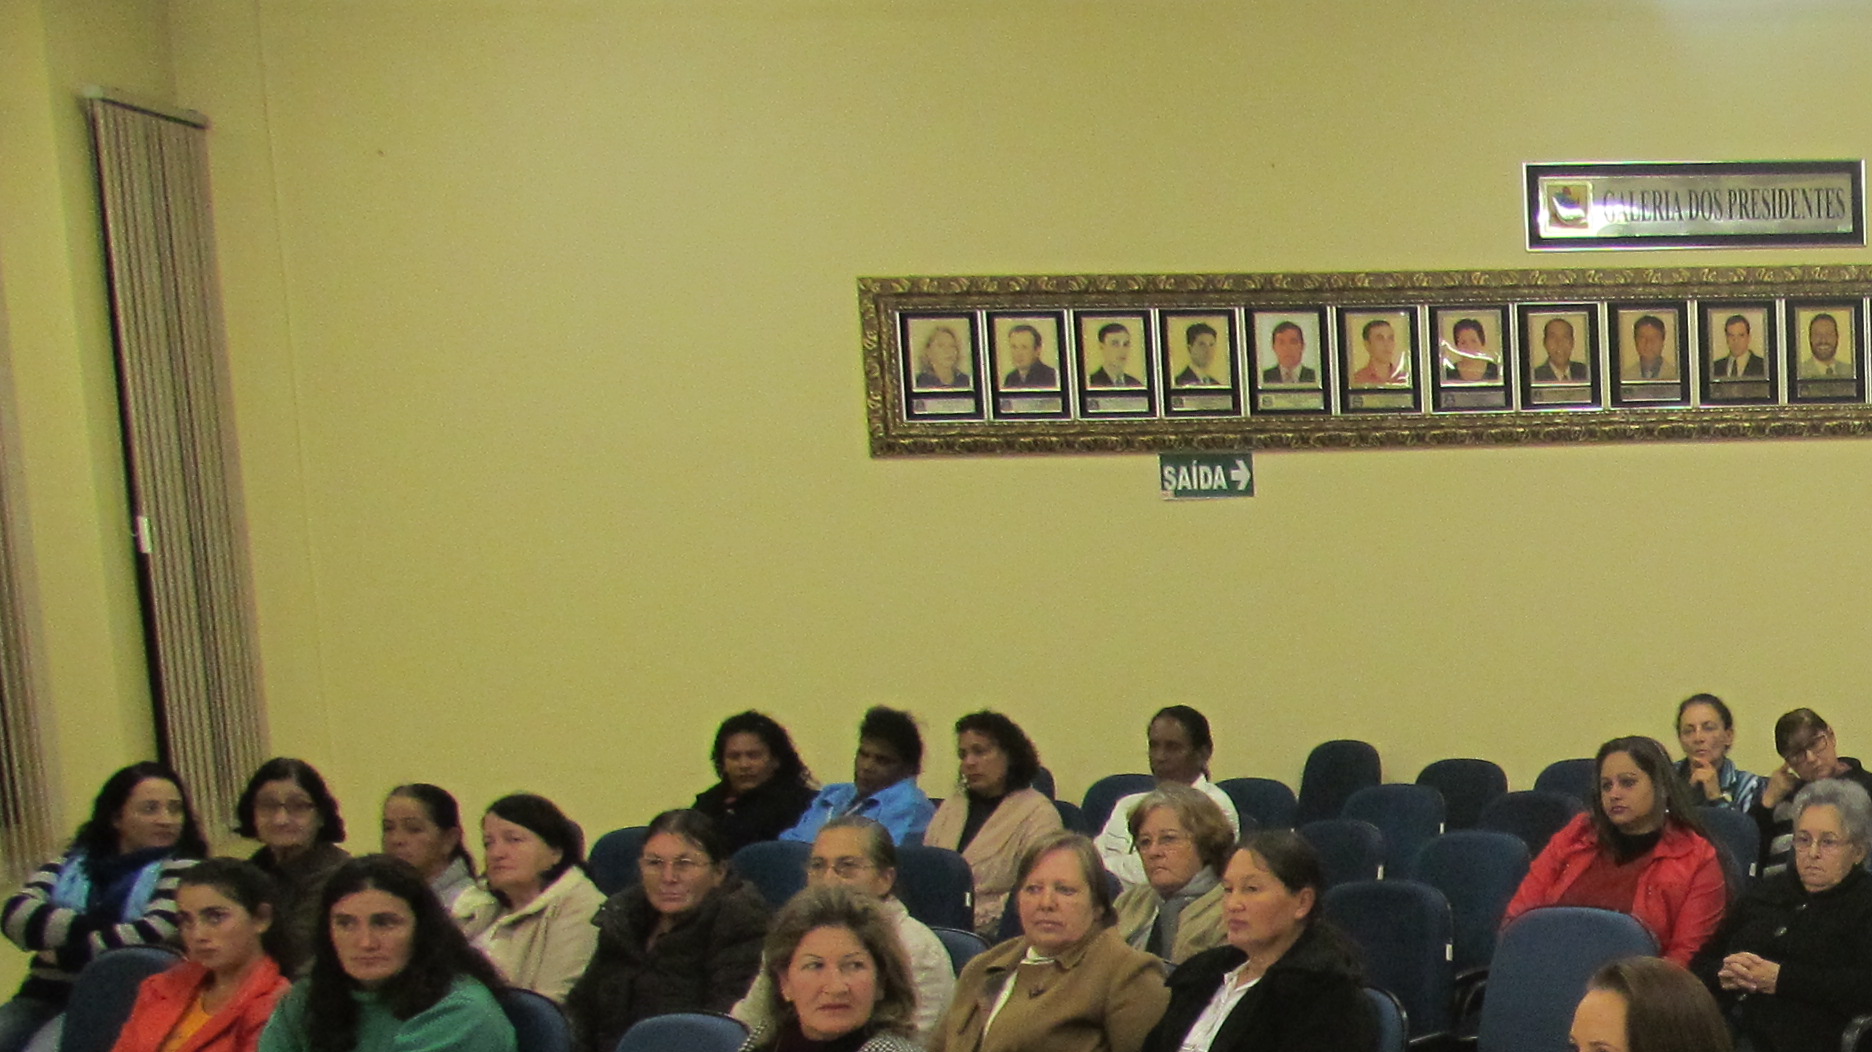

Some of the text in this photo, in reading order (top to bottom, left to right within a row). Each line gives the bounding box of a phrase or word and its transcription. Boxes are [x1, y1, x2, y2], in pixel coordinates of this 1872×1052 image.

[1602, 187, 1846, 222] GALERIA DOS PRESIDENTES
[1163, 460, 1228, 490] SAÍDA
